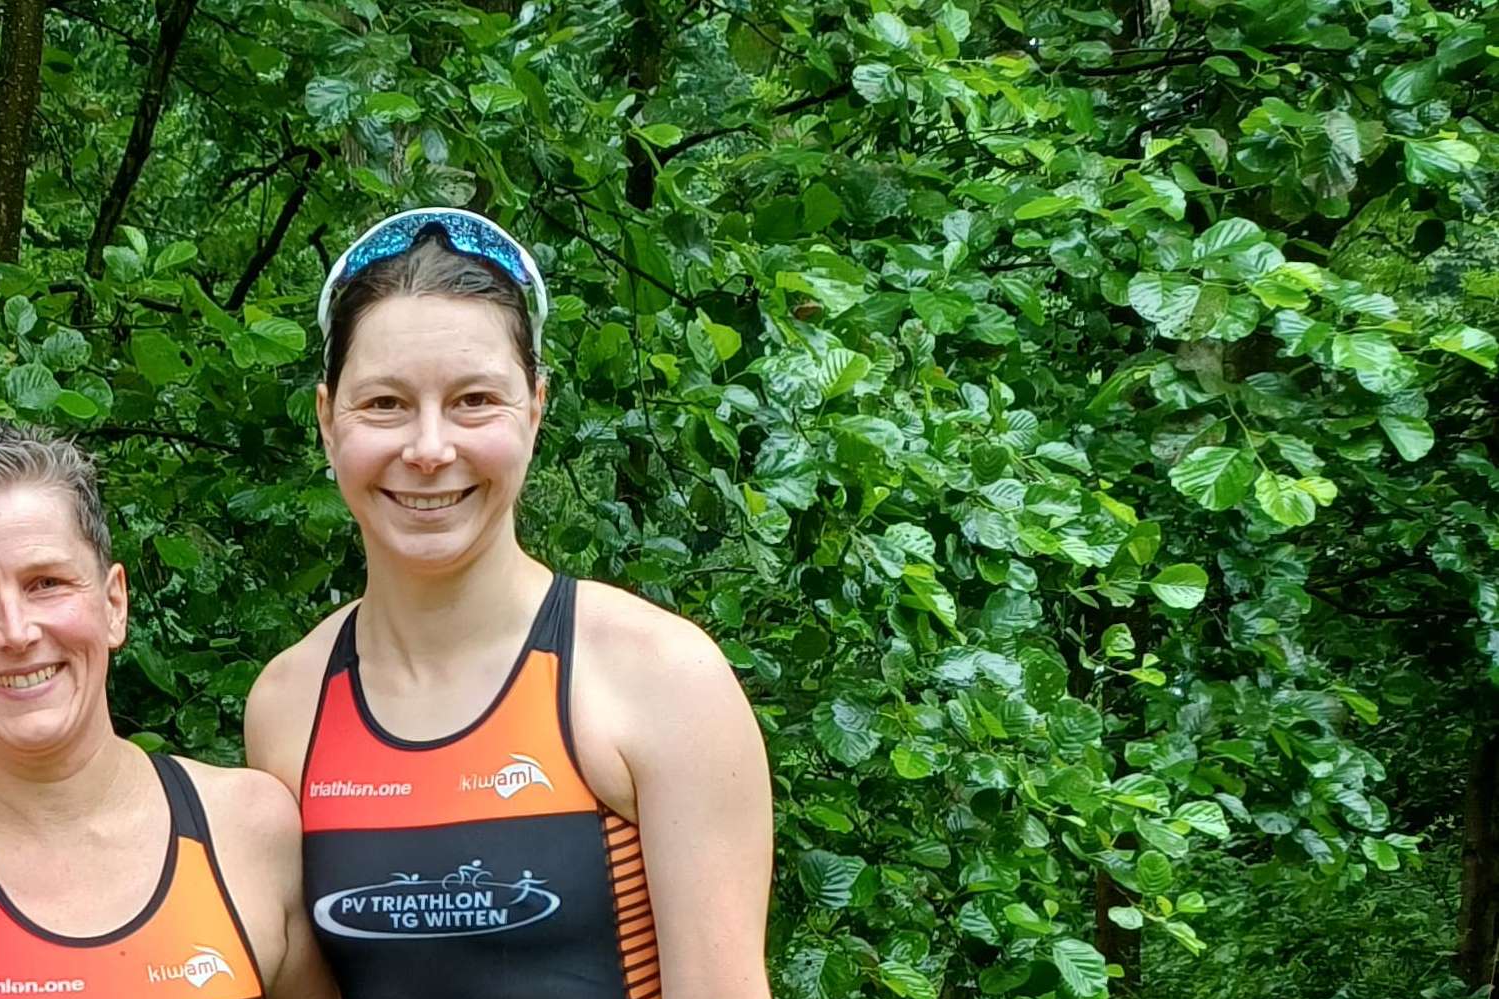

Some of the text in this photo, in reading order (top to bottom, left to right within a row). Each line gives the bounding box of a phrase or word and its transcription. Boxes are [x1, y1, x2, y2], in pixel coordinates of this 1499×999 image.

[308, 780, 412, 798] triathlon.one
[460, 766, 536, 792] kiwami
[341, 891, 494, 914] PV TRIATHLON
[389, 909, 509, 929] TG WITTEN
[147, 957, 223, 985] kiwami
